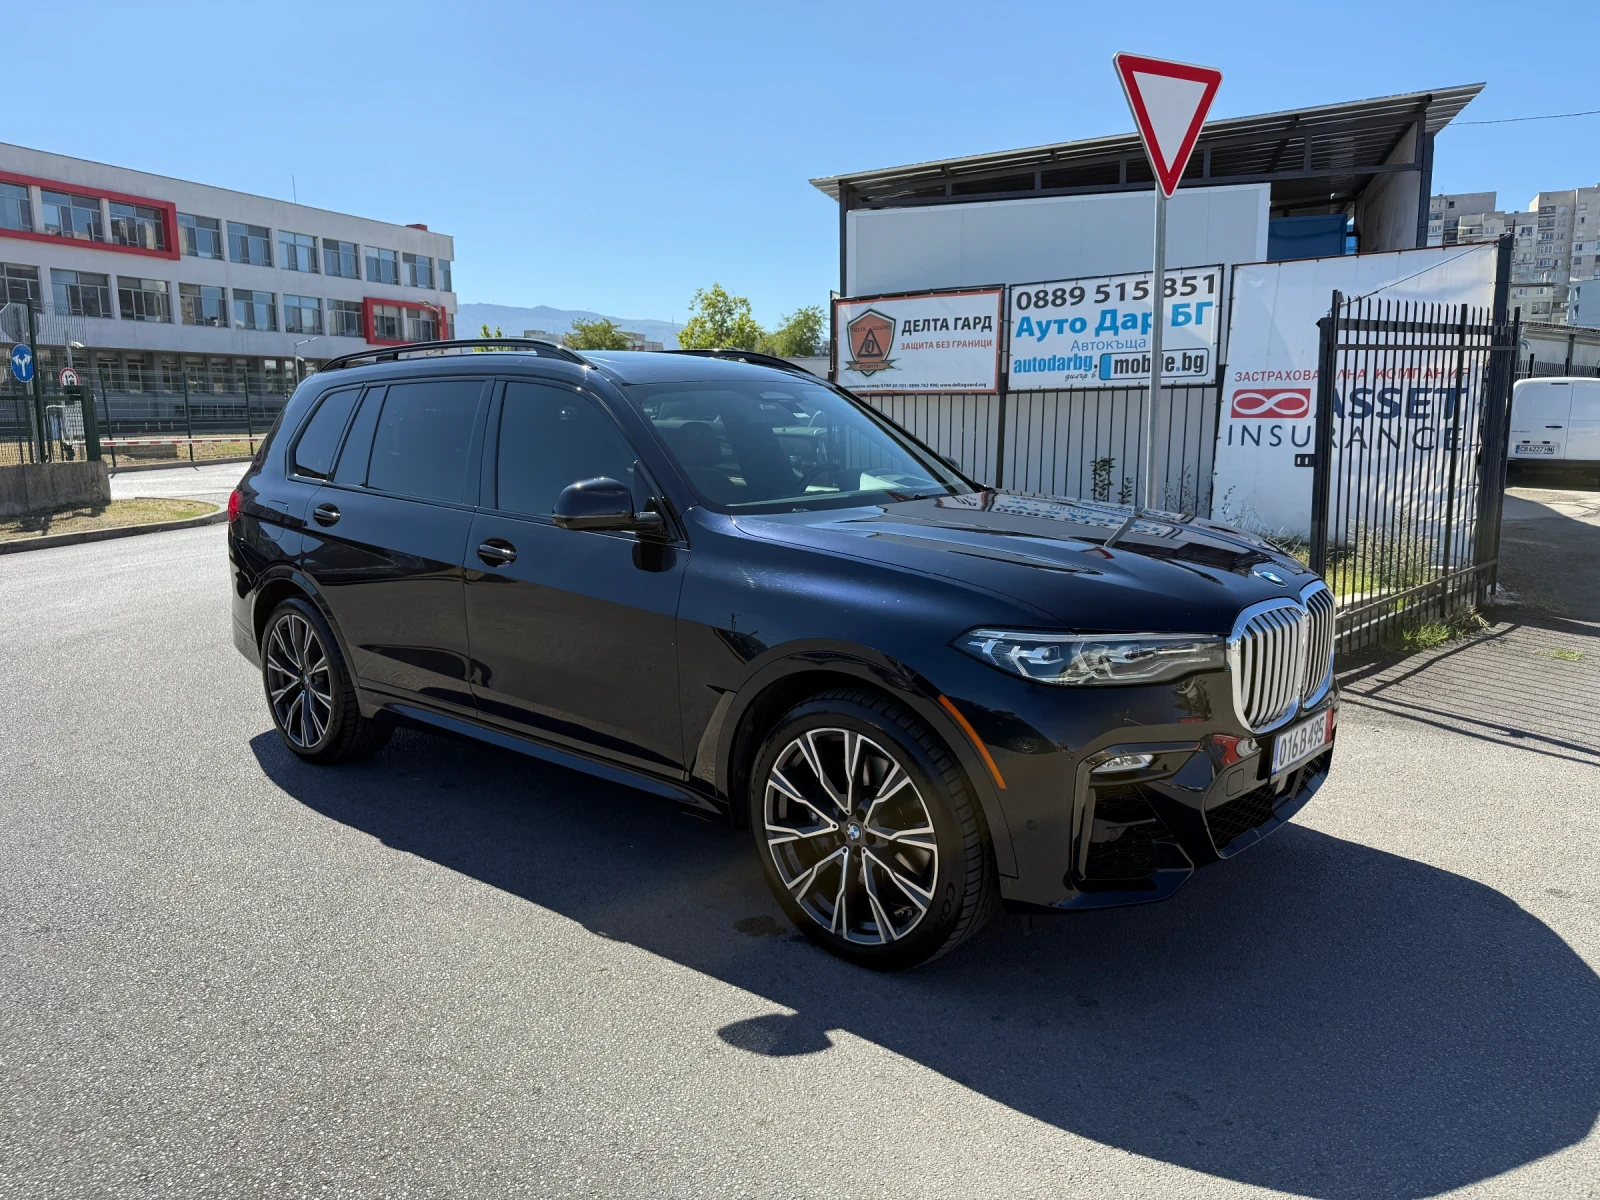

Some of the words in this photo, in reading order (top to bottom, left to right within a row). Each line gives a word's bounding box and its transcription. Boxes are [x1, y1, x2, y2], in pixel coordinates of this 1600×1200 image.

[1016, 286, 1086, 311] 0889
[1093, 280, 1149, 304] 515
[1163, 274, 1215, 298] 851
[901, 317, 950, 336] ДЕЛТА
[953, 315, 993, 333] ГАРД
[1015, 316, 1087, 342] Ауто
[1094, 308, 1153, 337] Дар
[1170, 301, 1214, 327] БГ
[901, 341, 934, 351] ЗАЩИТА
[935, 340, 951, 349] БЕЗ
[951, 339, 993, 349] ГРАНИЦИ
[1070, 338, 1147, 352] Автокъща
[1113, 352, 1205, 374] mobe.bg
[1234, 368, 1366, 382] ЗАСТРАХОВАЛНА
